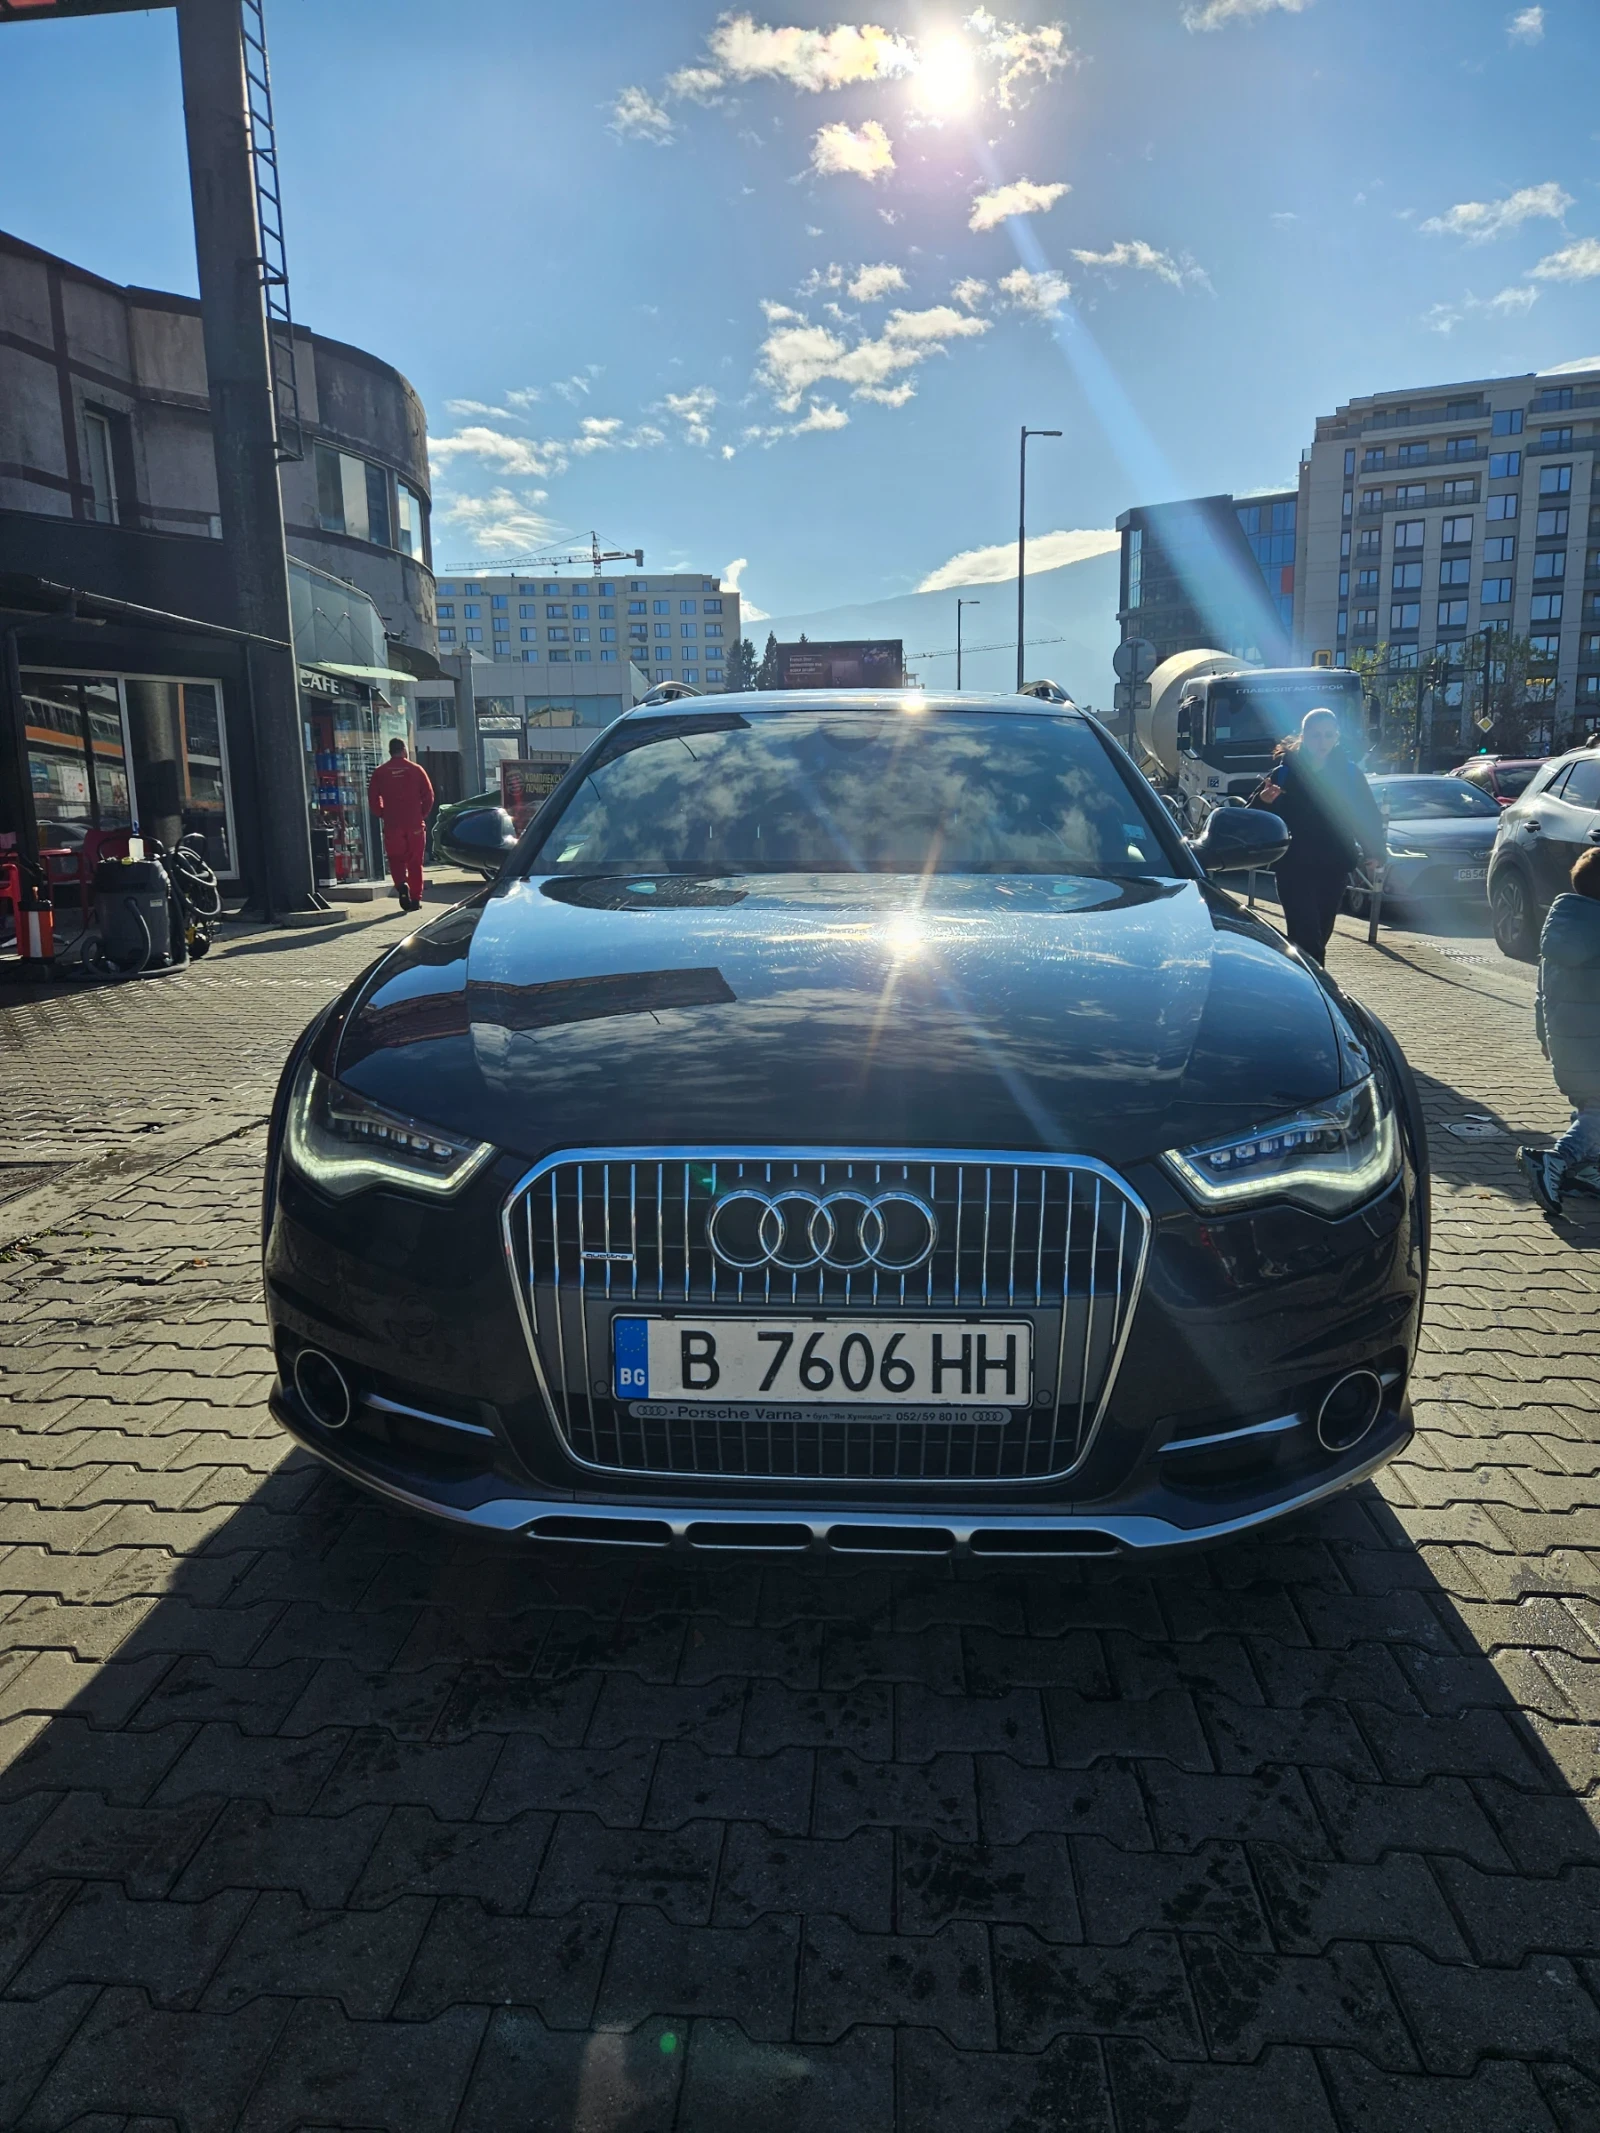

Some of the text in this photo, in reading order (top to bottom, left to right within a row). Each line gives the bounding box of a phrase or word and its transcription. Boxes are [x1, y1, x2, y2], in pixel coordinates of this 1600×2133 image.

[526, 784, 557, 794] ПОЧИСТВ
[681, 1330, 1016, 1395] B 7606 HH
[620, 1367, 646, 1386] BG
[678, 1406, 750, 1420] Porsche
[755, 1408, 803, 1421] Varna
